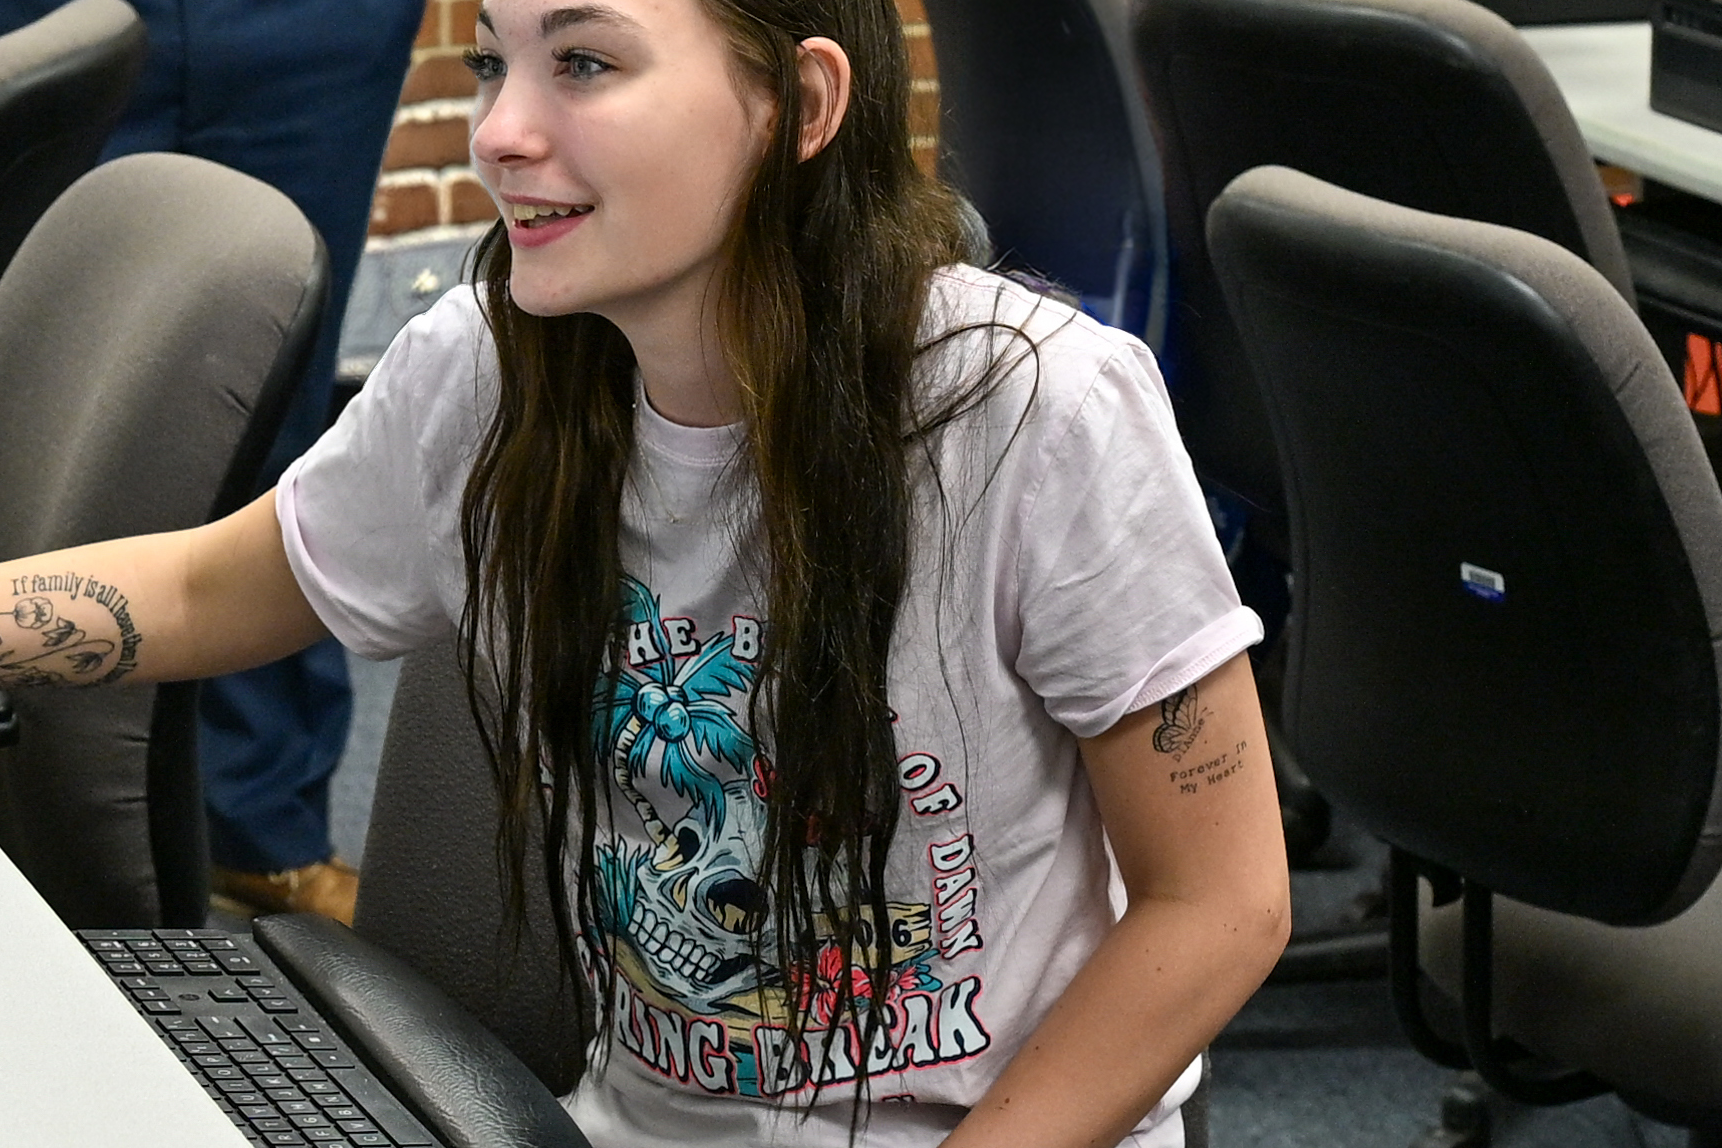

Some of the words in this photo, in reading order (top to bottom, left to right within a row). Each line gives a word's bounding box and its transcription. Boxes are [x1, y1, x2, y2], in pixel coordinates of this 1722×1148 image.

[10, 575, 28, 596] If
[31, 571, 84, 600] family
[83, 574, 99, 598] is
[95, 584, 119, 608] all
[605, 616, 702, 670] HE
[899, 752, 963, 815] OF
[1169, 753, 1229, 783] Forever
[1180, 781, 1199, 795] My
[1207, 760, 1245, 787] Heart
[930, 833, 983, 960] DAWN
[754, 974, 991, 1098] BREAK
